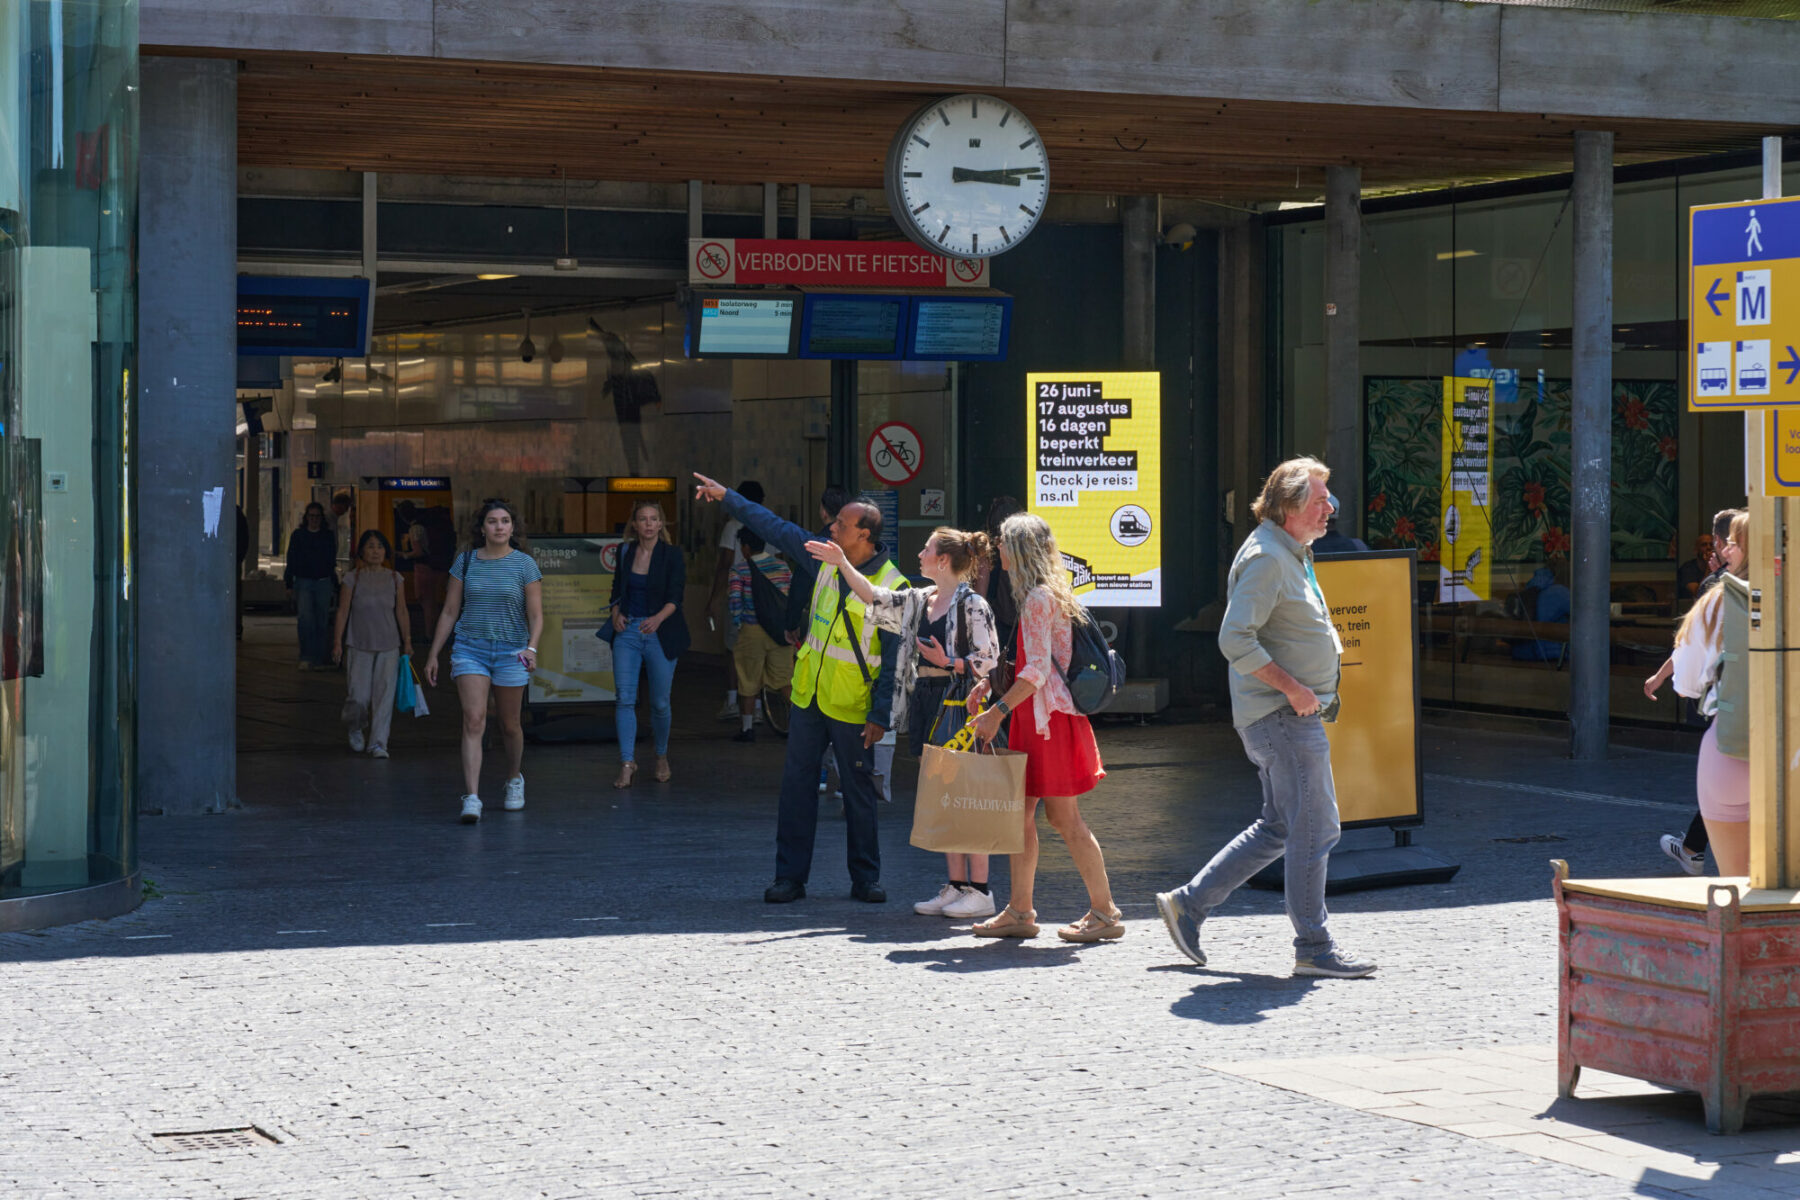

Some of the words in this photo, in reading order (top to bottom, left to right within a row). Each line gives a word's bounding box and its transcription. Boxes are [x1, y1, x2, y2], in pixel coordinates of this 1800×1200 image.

[737, 252, 843, 272] VERBODEN
[845, 254, 867, 272] TE
[872, 254, 944, 273] FIETSEN
[720, 300, 758, 308] Isolatorweg
[1741, 286, 1766, 320] M
[1040, 384, 1059, 398] 26
[1062, 383, 1092, 401] juni
[1039, 402, 1055, 414] 17
[1058, 402, 1128, 418] augustus
[1039, 419, 1056, 432] 16
[1060, 418, 1107, 435] dagen
[1040, 436, 1100, 453] beperkt
[1039, 453, 1134, 467] treinverkeer
[1040, 473, 1083, 486] Check
[1086, 473, 1099, 491] je
[1103, 474, 1133, 486] reis:
[1040, 490, 1074, 502] ns.nl
[532, 547, 577, 559] Passage
[1330, 605, 1368, 615] vervoer
[1348, 619, 1370, 631] trein
